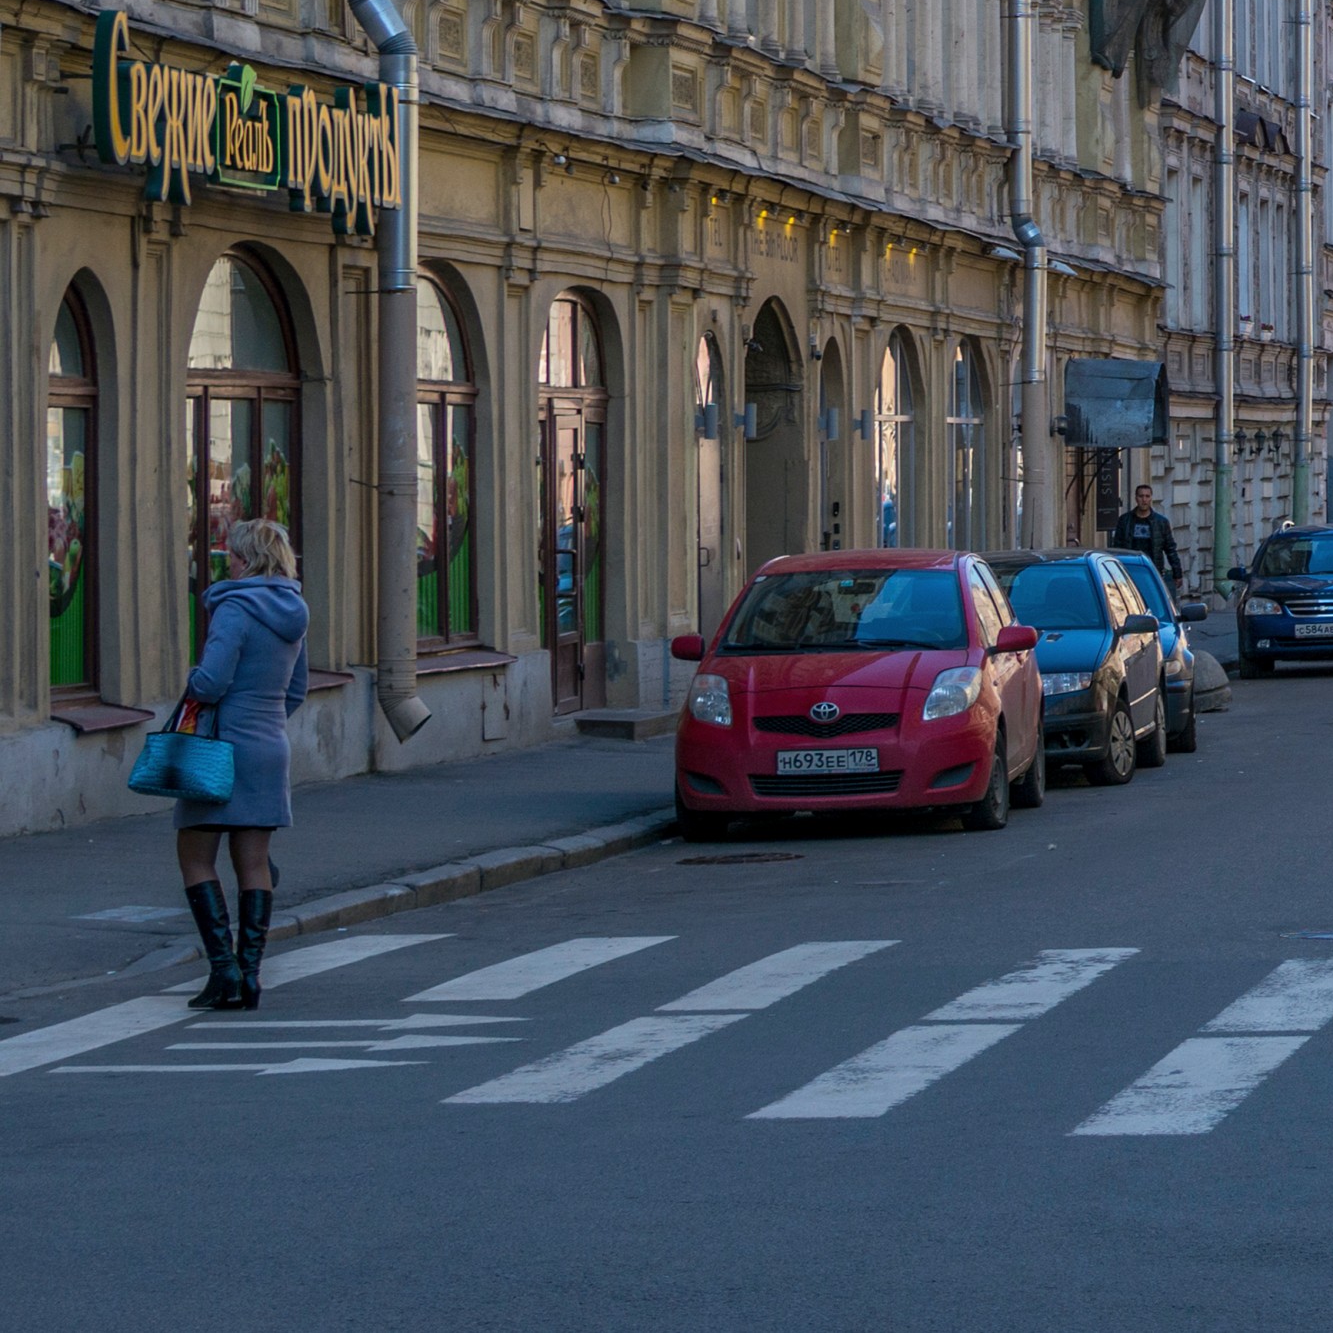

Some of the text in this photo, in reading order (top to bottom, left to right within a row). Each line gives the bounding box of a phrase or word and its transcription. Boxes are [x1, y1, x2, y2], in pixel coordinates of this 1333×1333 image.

[108, 10, 217, 206] Свежие
[777, 232, 799, 264] FLOOR
[849, 750, 873, 764] 178
